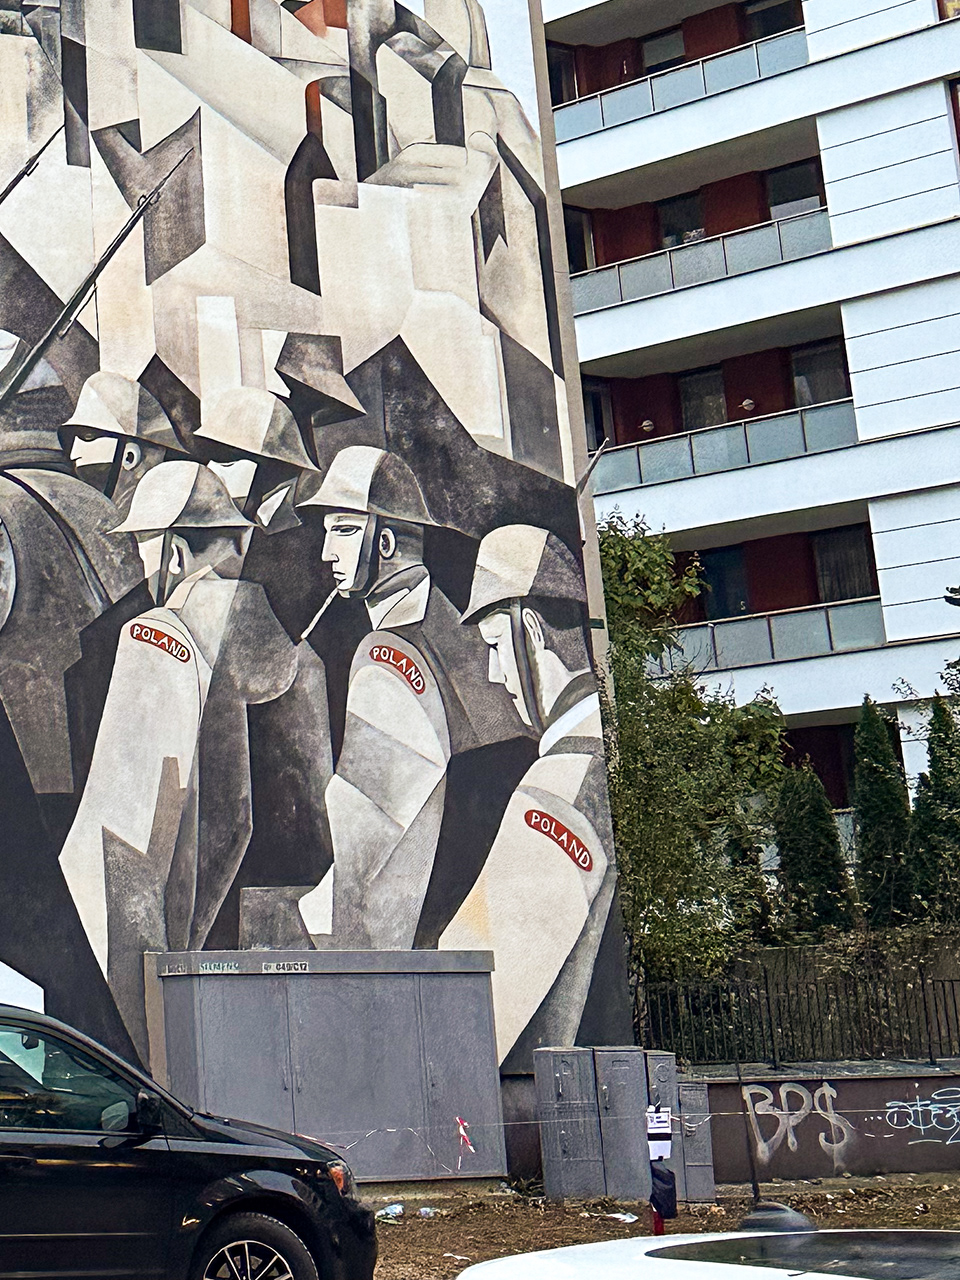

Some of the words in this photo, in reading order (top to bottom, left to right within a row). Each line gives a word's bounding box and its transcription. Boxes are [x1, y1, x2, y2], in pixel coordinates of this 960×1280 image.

[132, 624, 189, 661] POLAND
[372, 647, 424, 691] POLAND
[530, 811, 590, 868] POLAND
